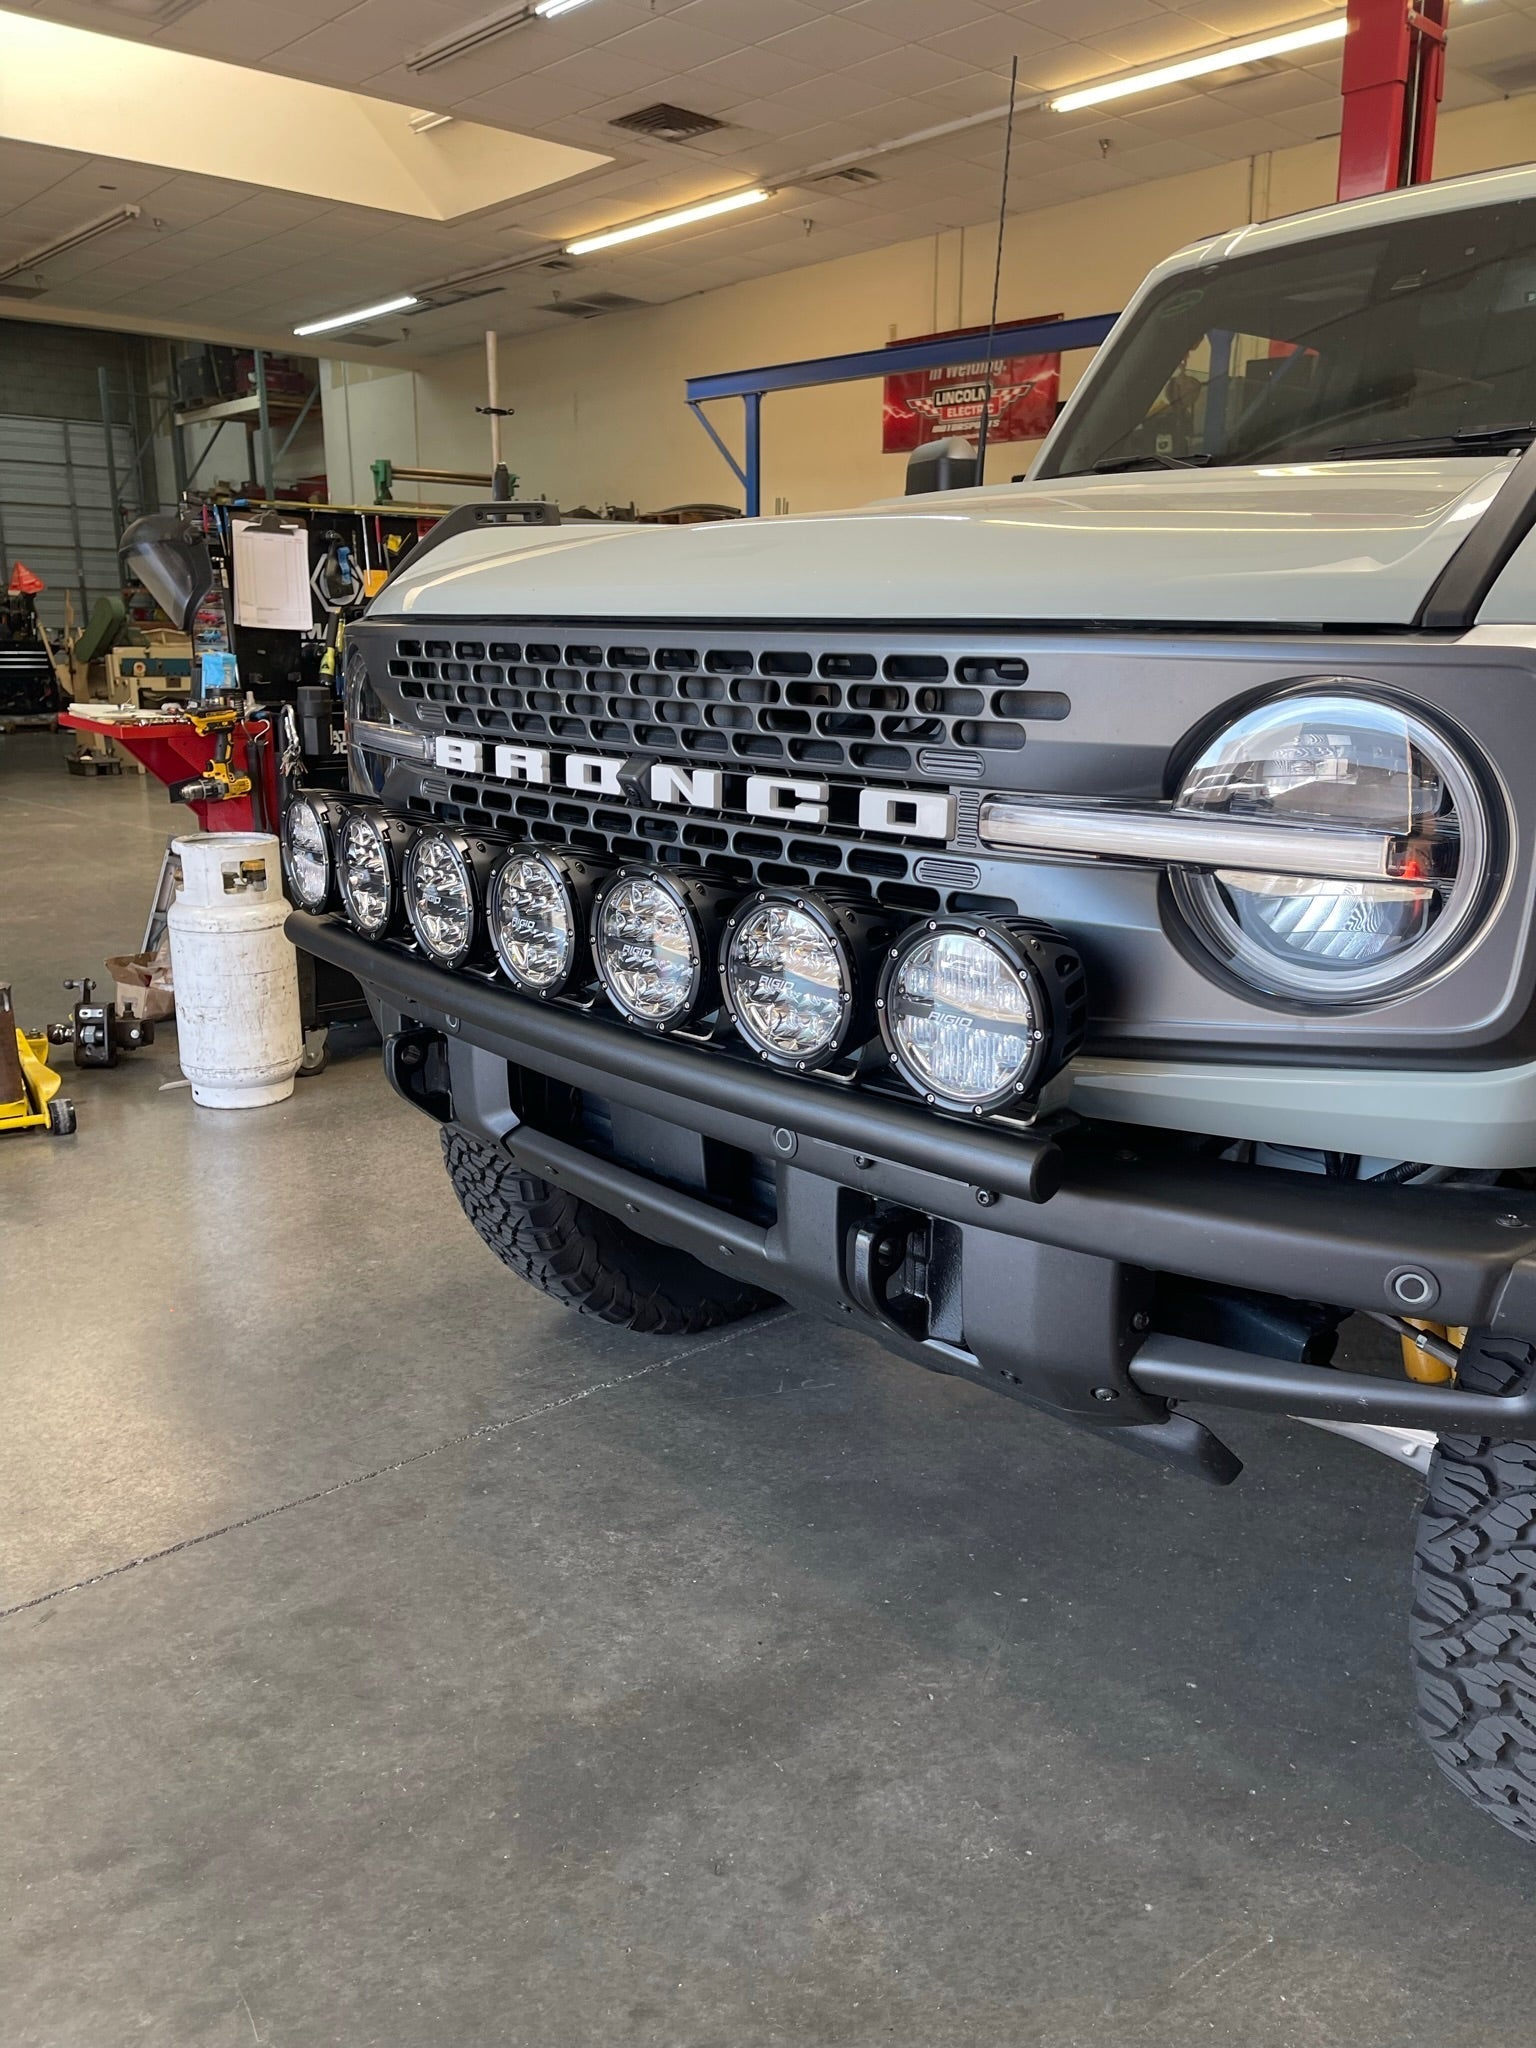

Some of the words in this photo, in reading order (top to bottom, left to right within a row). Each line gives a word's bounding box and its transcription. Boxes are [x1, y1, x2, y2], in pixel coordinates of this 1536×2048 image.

[935, 387, 987, 406] LINCOLN
[946, 403, 994, 418] ELECTRC
[435, 735, 957, 842] BRONCO
[511, 917, 535, 929] RIGID
[622, 944, 652, 958] RIGID
[760, 975, 795, 990] RIGID
[928, 1011, 974, 1027] RIGID
